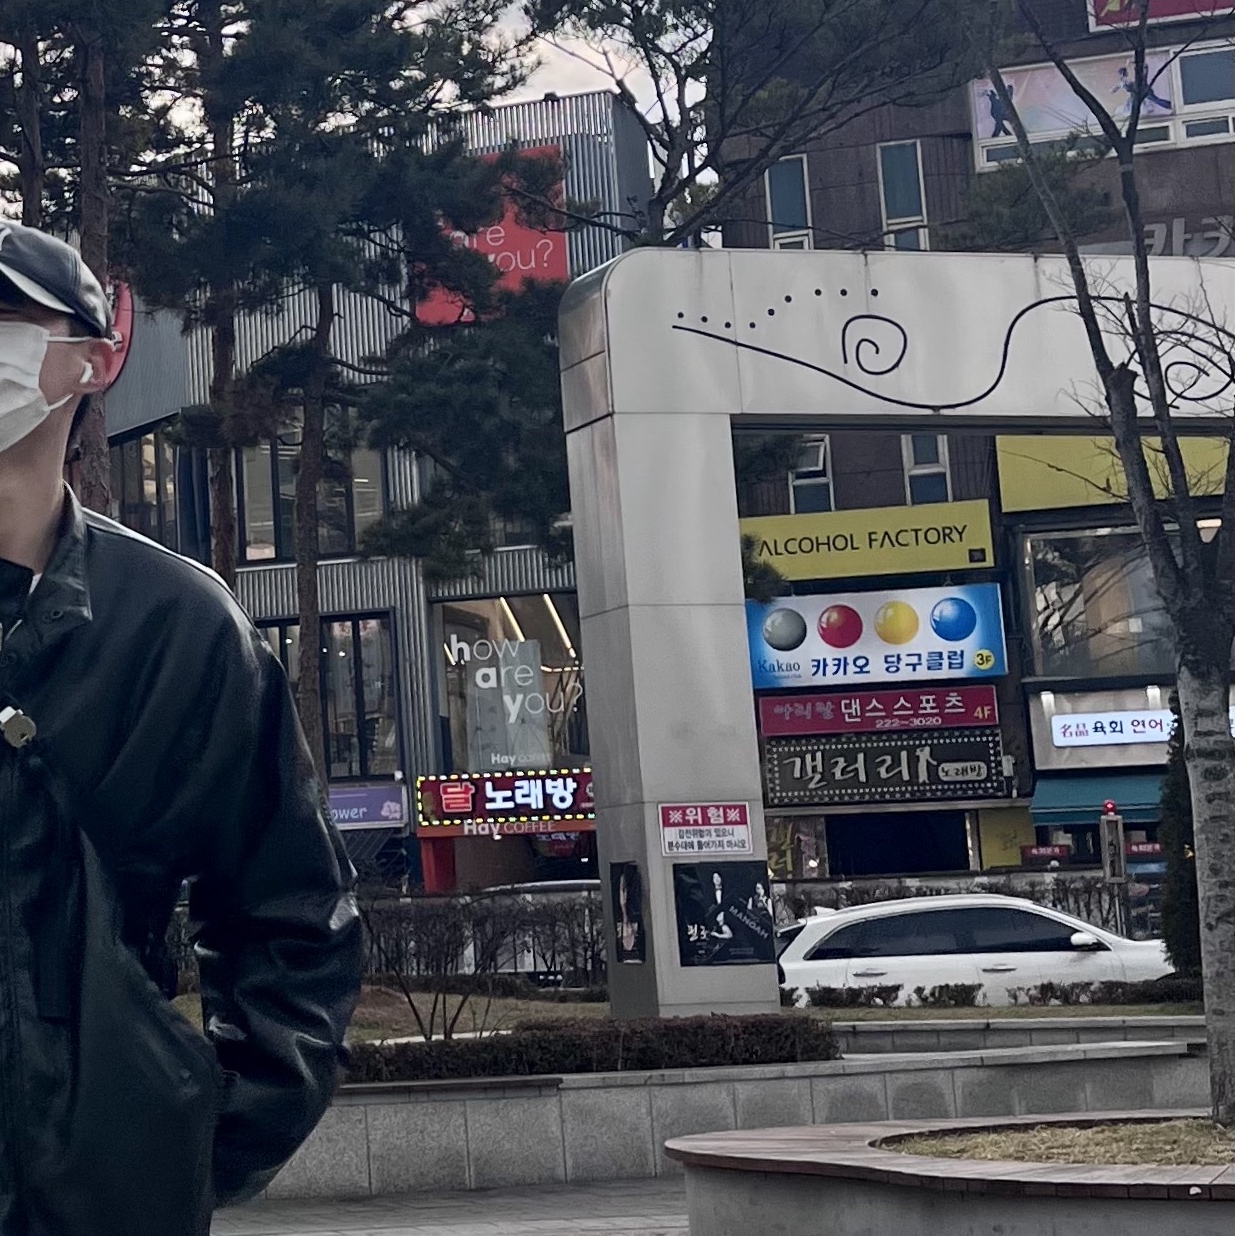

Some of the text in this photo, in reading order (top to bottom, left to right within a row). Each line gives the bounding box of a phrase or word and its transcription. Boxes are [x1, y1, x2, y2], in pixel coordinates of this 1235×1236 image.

[488, 239, 554, 273] ou?
[758, 525, 968, 557] ALCOHOL FACTORY
[450, 634, 521, 661] how
[475, 664, 534, 689] are
[758, 658, 801, 673] Kakao
[811, 650, 992, 677] 카카오 당구클럽 3F
[503, 677, 584, 724] you?
[841, 692, 966, 723] 댄스스포츠
[973, 706, 992, 719] 4F
[1092, 720, 1124, 735] 육회
[1131, 719, 1164, 734] 연어
[490, 753, 516, 766] Hay
[783, 750, 910, 789] 갤러리
[942, 766, 983, 781] 노래방
[439, 782, 475, 812] 달
[485, 777, 577, 811] 노래방
[464, 819, 556, 840] Hay COFFEE
